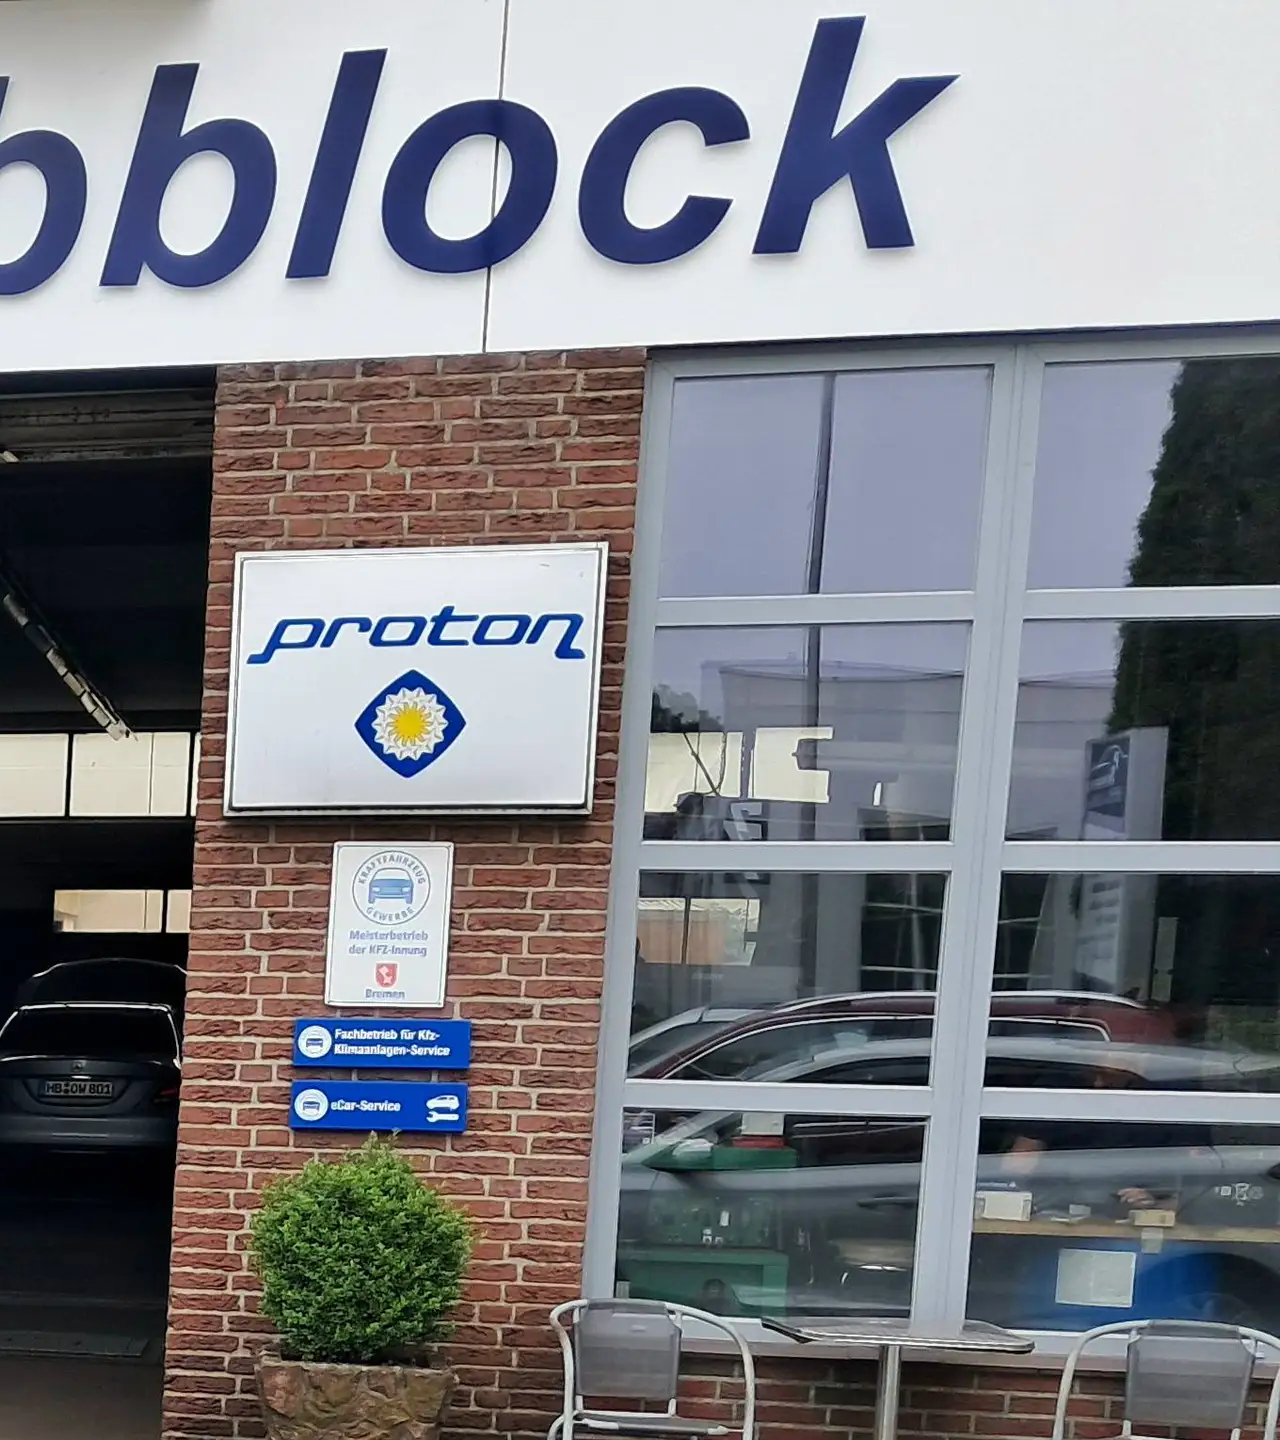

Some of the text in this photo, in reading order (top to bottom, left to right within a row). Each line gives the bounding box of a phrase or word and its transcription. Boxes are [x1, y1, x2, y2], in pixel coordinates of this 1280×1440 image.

[246, 604, 587, 666] proton
[357, 853, 426, 885] KRAFTFAHRZEUG
[366, 906, 415, 921] GEWERBE
[349, 929, 429, 942] Meisterbetrieb
[348, 944, 428, 957] der KFZ-Innung
[365, 988, 406, 999] Bremen
[334, 1028, 441, 1041] Fachbetrieb für Kfz-
[333, 1044, 451, 1058] Klimaanlagen-Service
[330, 1099, 401, 1112] eCar-Service
